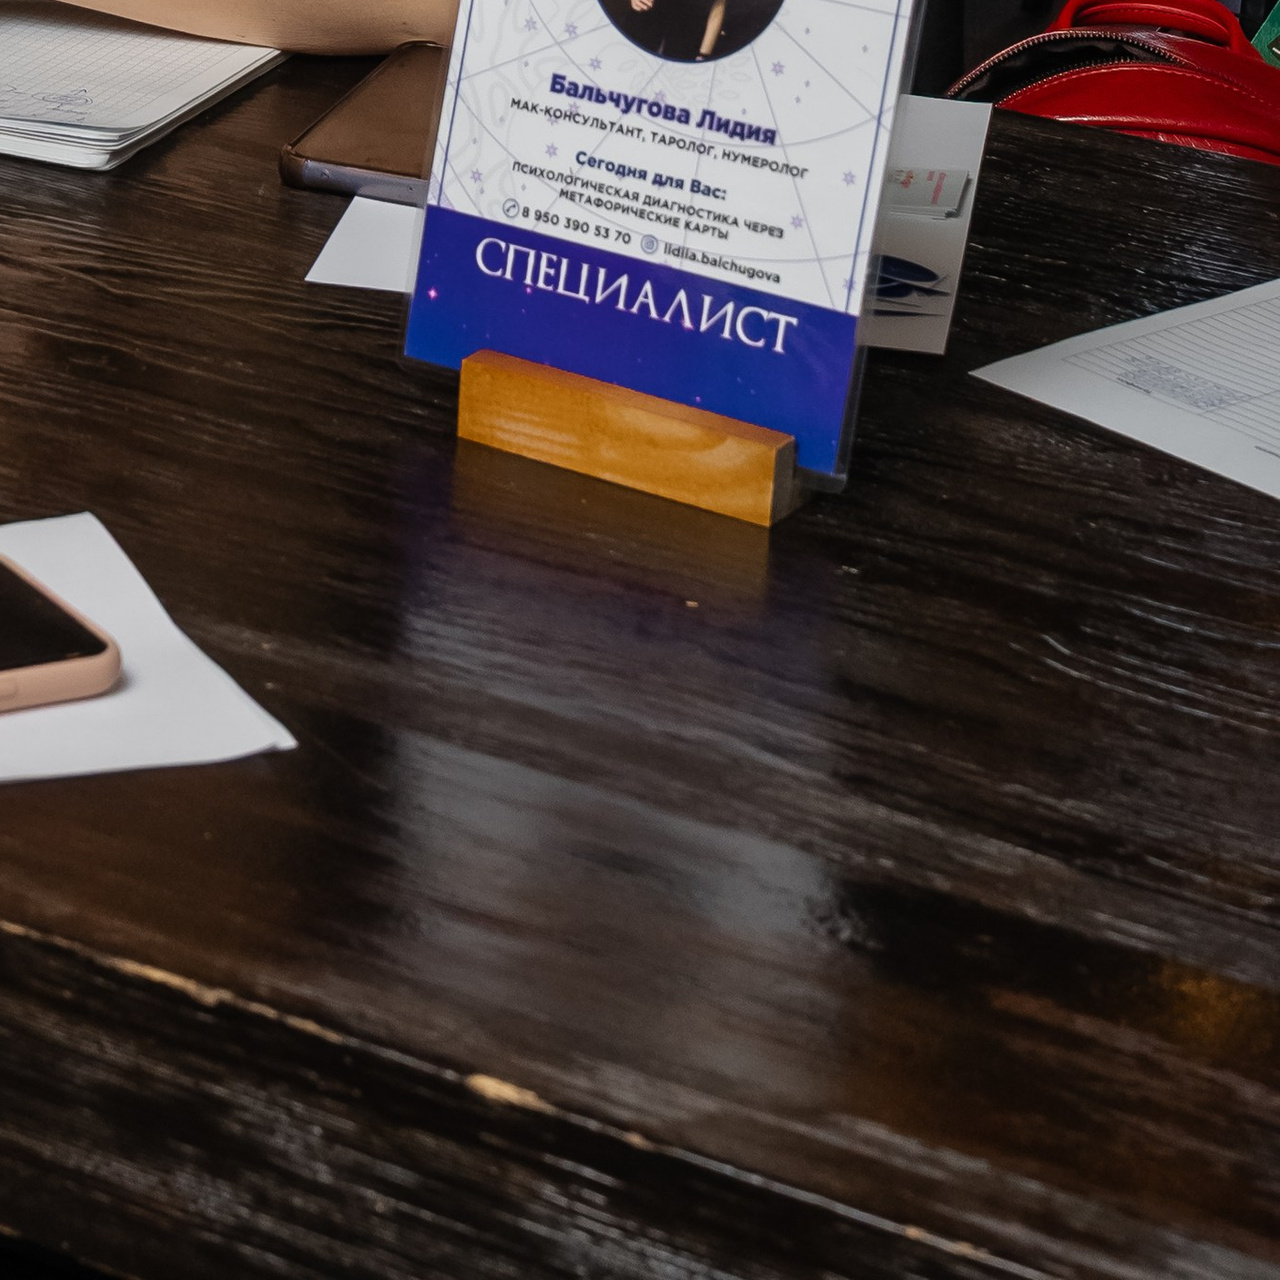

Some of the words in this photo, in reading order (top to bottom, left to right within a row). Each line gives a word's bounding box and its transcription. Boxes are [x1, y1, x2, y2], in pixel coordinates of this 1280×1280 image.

[510, 97, 646, 142] МАК-КОНСУЛЬТАНТ,
[650, 131, 718, 160] ТАРОЛОГ,
[722, 148, 809, 180] НУМЕРОЛОГ
[549, 72, 691, 126] Бальчугова
[695, 108, 778, 147] Лидия
[512, 160, 640, 201] ПСИХОЛОГИЧЕСКАЯ
[642, 194, 740, 228] ДИАГНОСТИКА
[743, 219, 785, 239] ЧЕРЕЗ
[575, 150, 647, 181] Сегодня
[651, 172, 685, 190] для
[689, 178, 728, 201] Вас:
[521, 206, 530, 218] 8
[534, 209, 560, 226] 950
[563, 216, 590, 234] 390
[593, 224, 610, 239] 53
[614, 229, 631, 244] 70
[559, 188, 681, 228] МЕТАФОРИЧЕСКИЕ
[683, 219, 729, 240] КАРТЫ
[475, 237, 798, 354] СПЕЦИАЛИСТ
